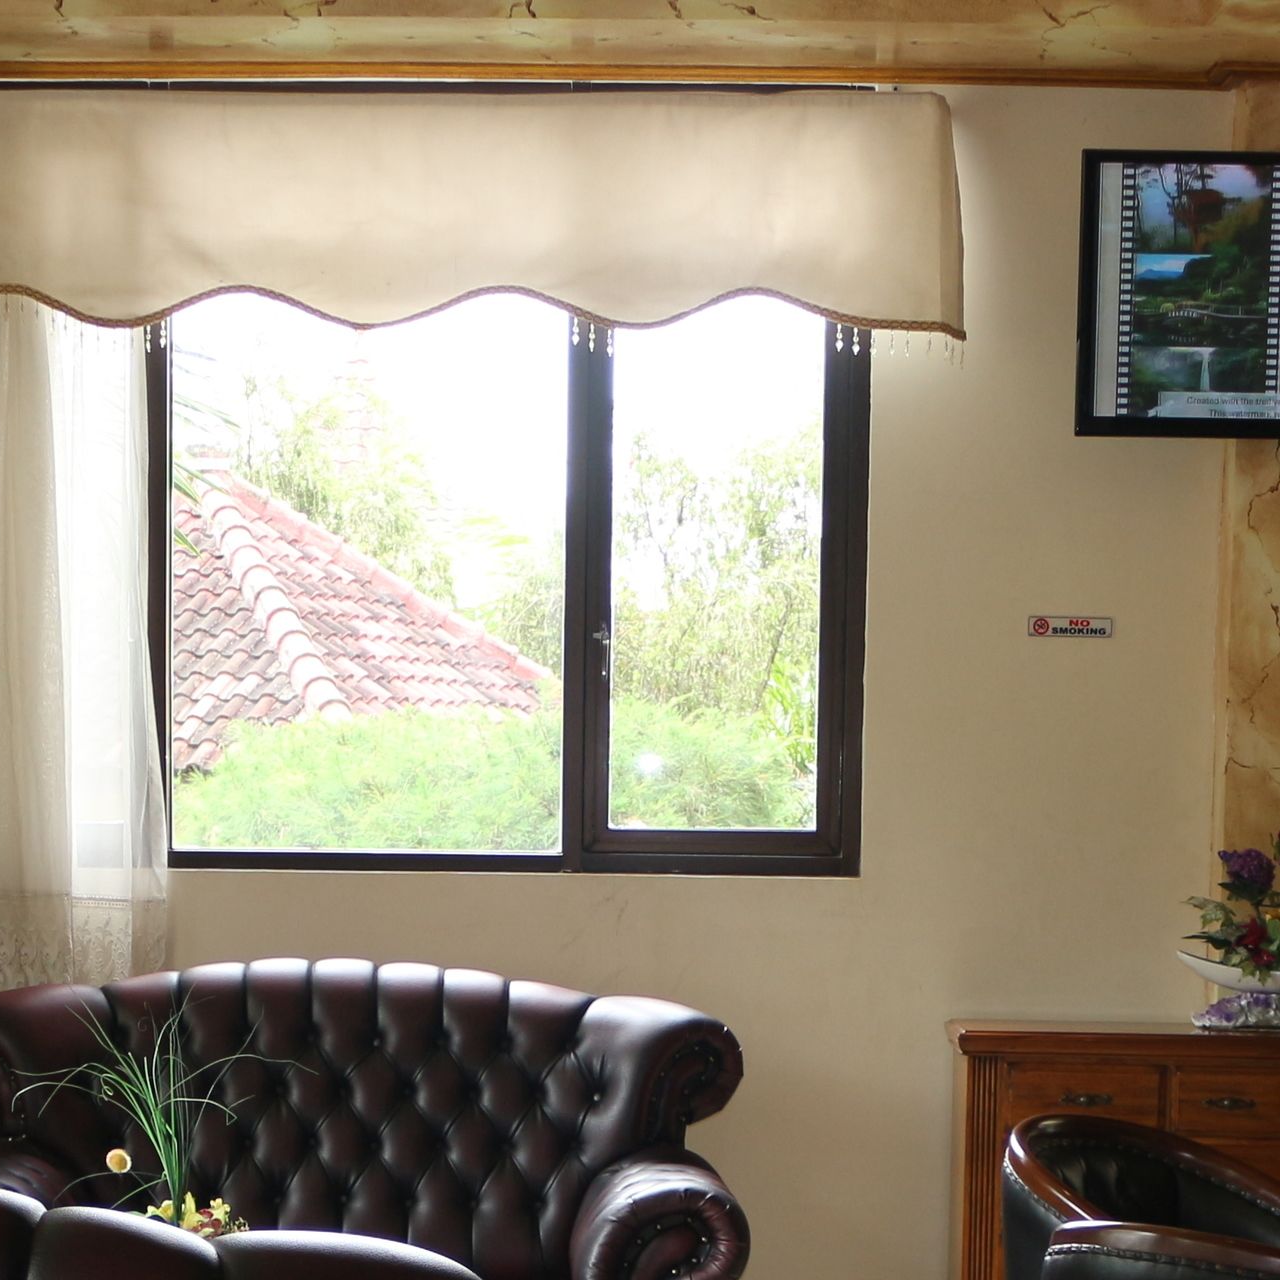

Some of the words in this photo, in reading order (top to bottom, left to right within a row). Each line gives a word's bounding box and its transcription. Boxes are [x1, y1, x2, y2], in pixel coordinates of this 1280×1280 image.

[1187, 397, 1218, 406] Created
[1069, 619, 1090, 627] NO
[1052, 627, 1106, 635] SMOKING
